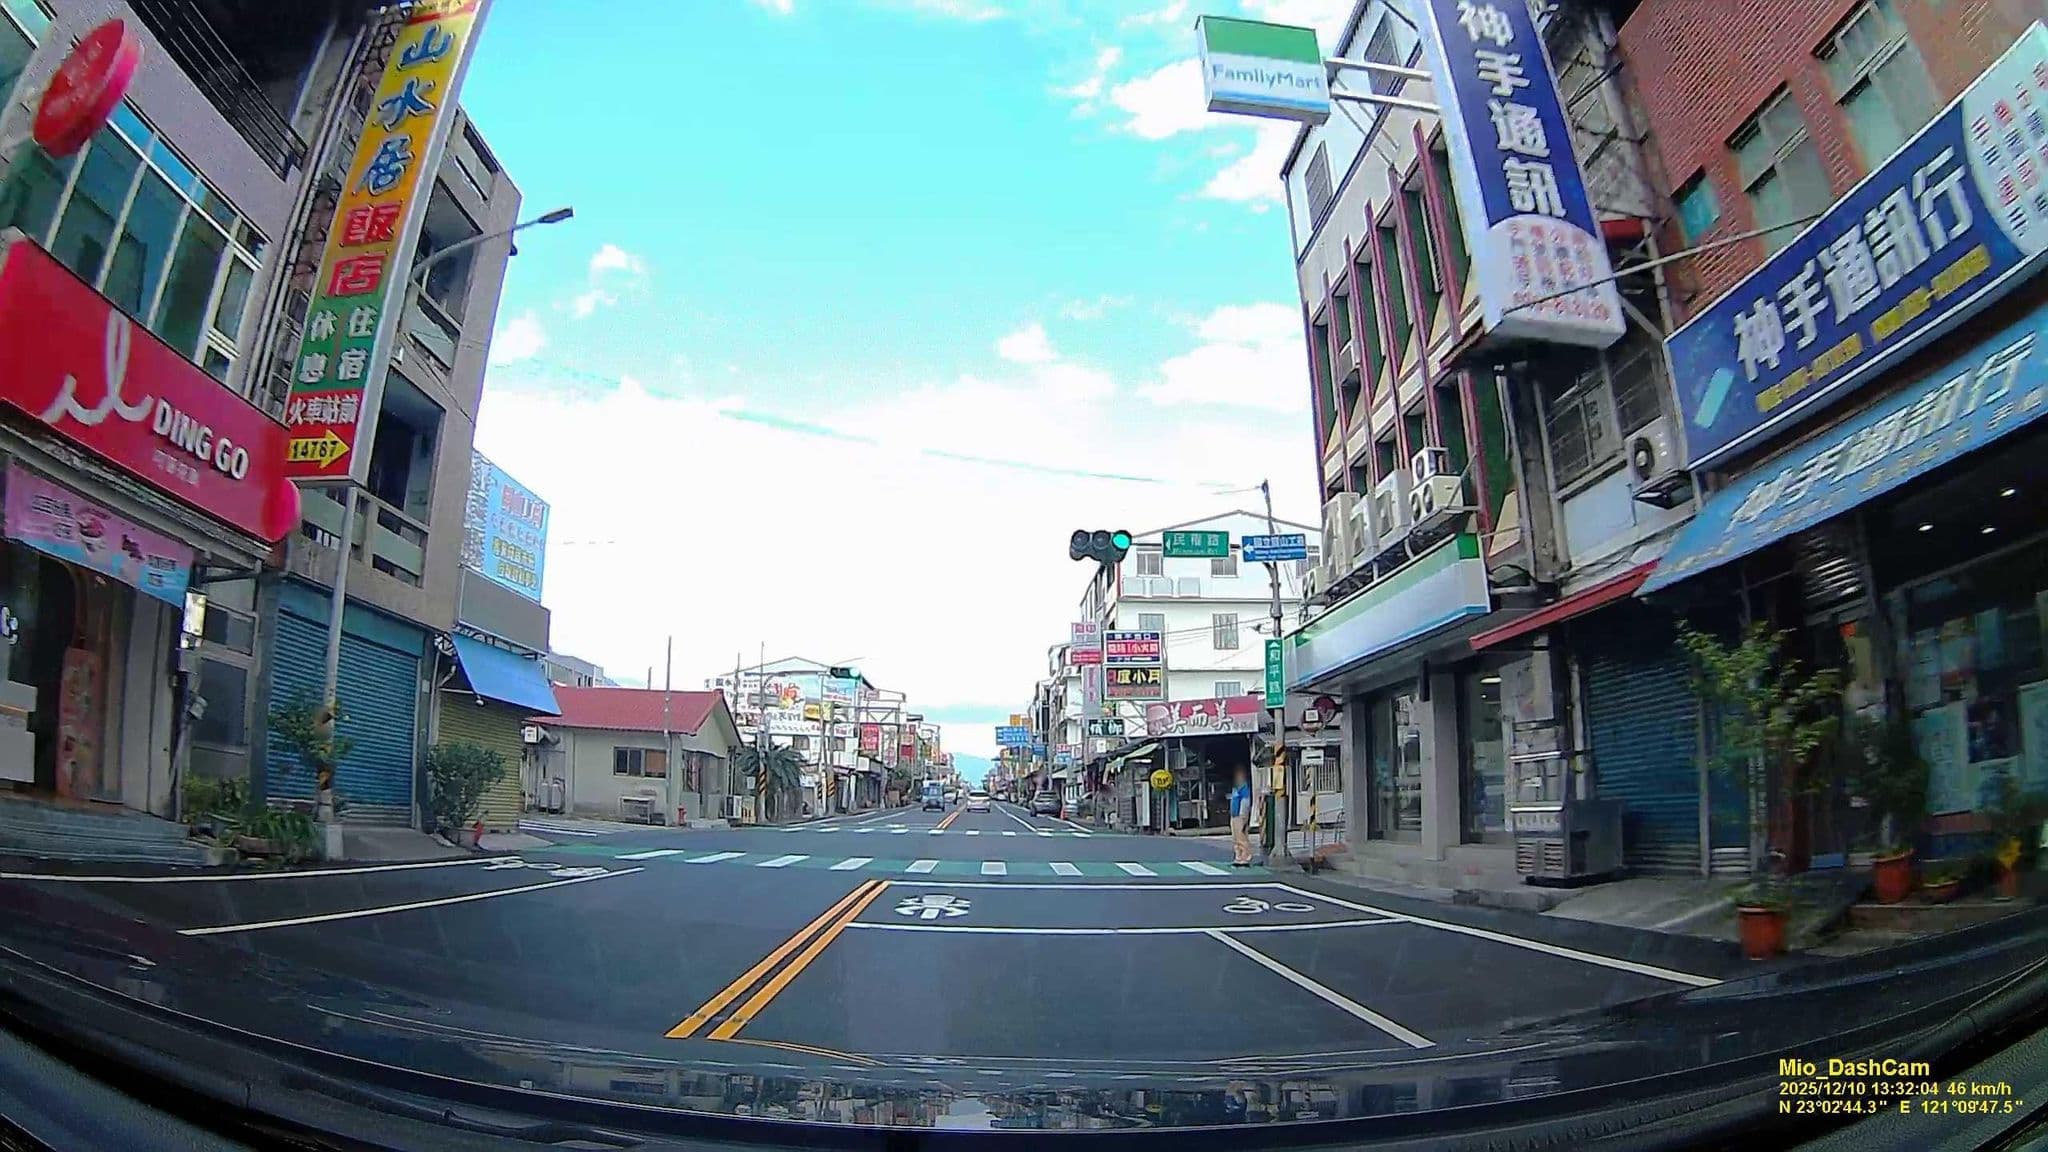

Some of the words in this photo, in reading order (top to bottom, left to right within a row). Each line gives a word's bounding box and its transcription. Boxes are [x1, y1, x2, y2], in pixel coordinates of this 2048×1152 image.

[1212, 63, 1322, 90] FamilyMart
[1734, 145, 1974, 383] 神手通訊行
[153, 398, 213, 461] DING
[215, 437, 249, 480] GO
[1167, 699, 1233, 733] 美而美
